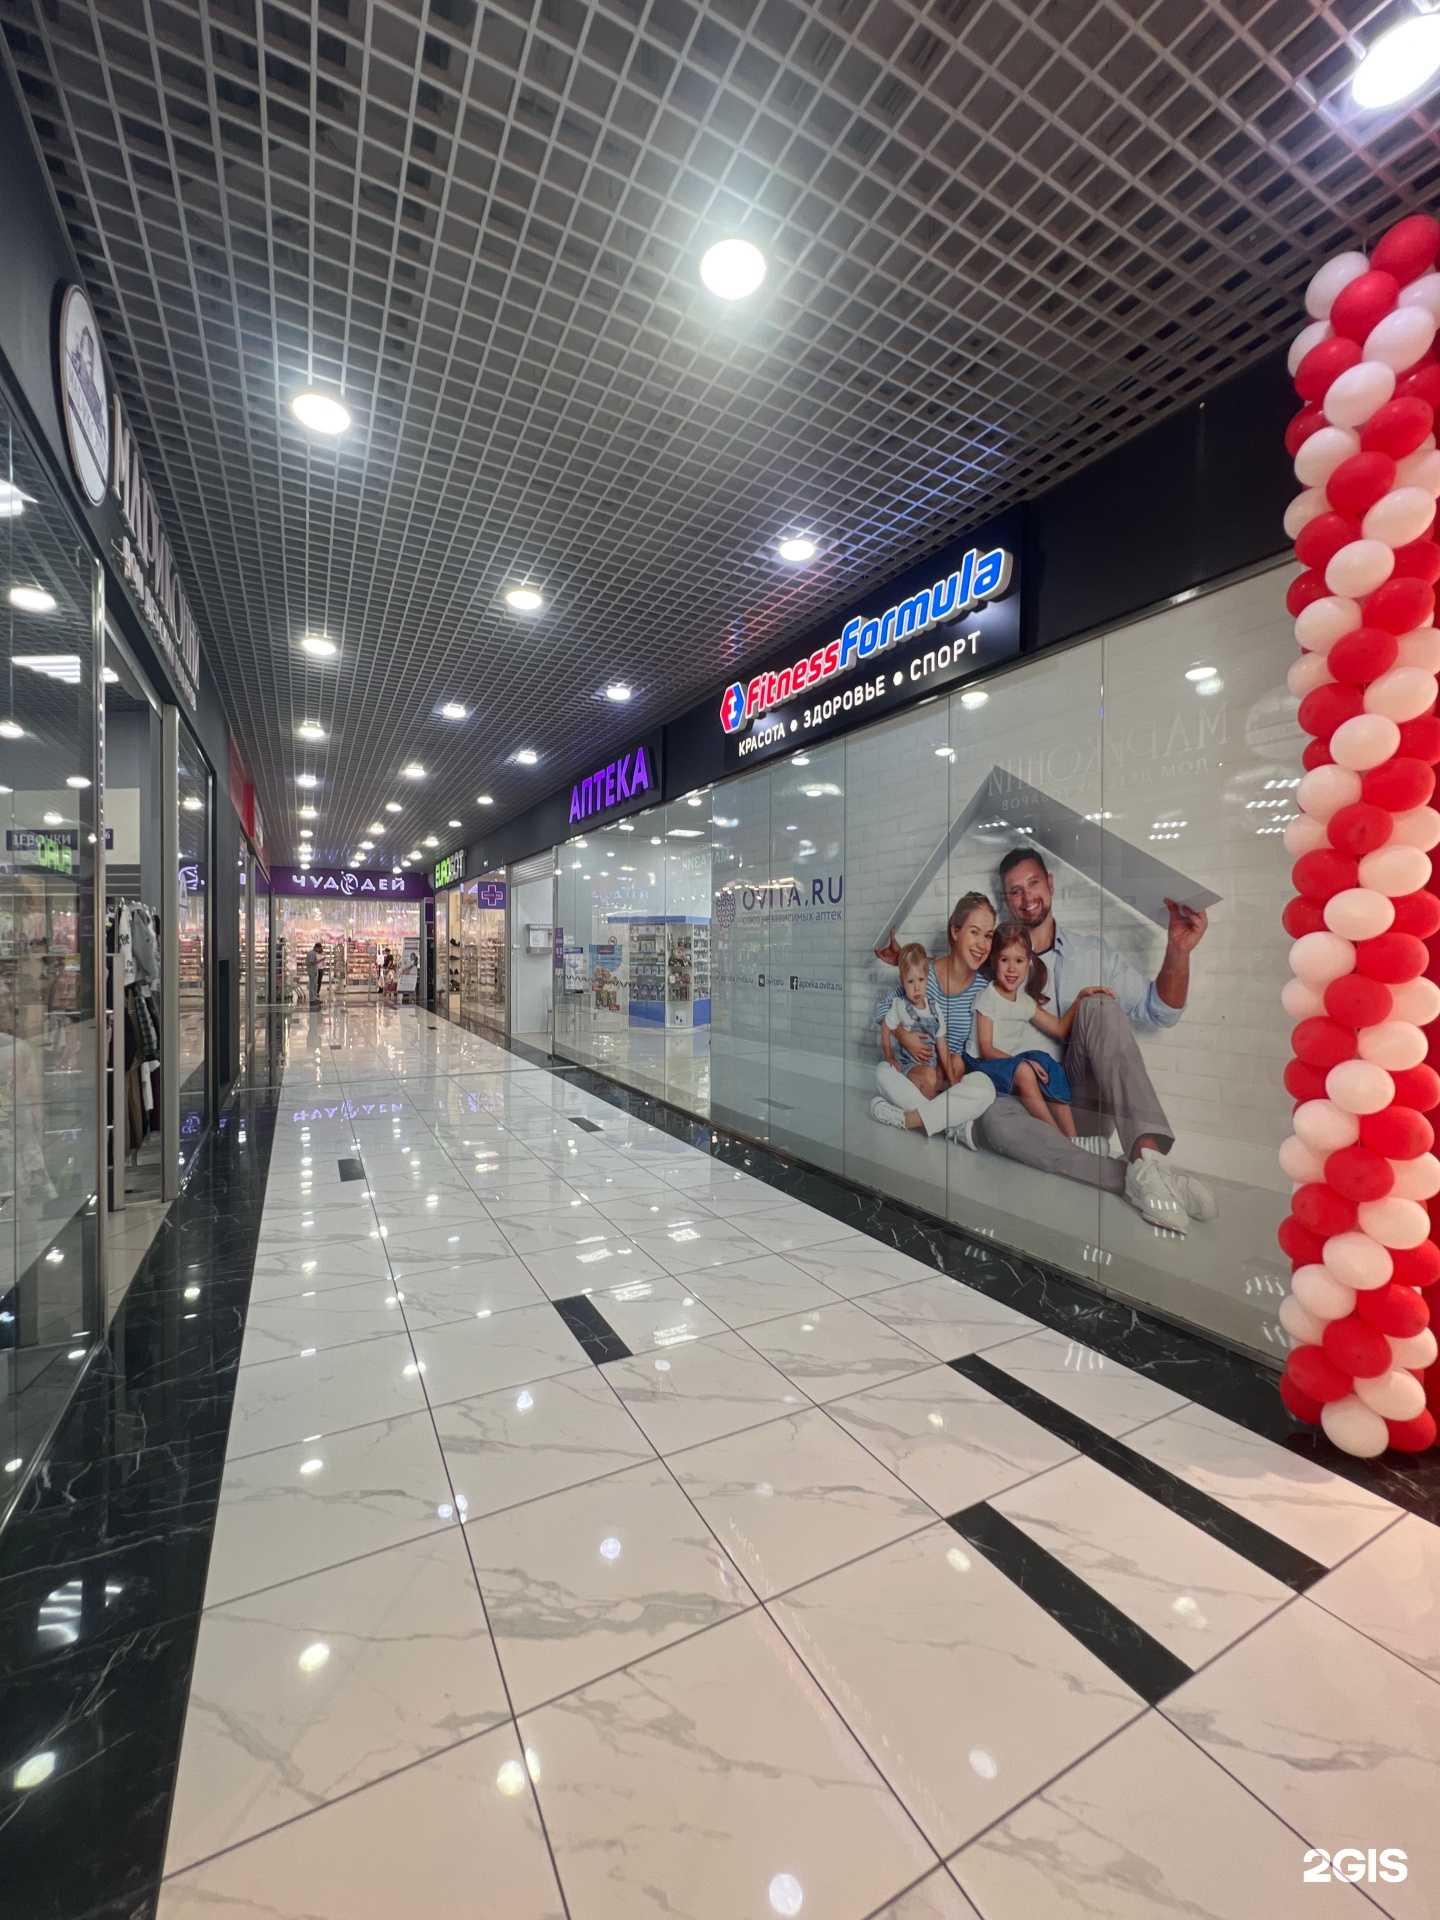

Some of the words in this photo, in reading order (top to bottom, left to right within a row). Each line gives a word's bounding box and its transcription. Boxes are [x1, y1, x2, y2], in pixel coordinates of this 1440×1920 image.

[738, 722, 786, 757] КРАСОТА
[803, 674, 886, 729] ЗДОРОВЬЕ
[910, 630, 982, 681] СПОРТ
[744, 547, 1008, 720] FitnessFormula
[568, 745, 649, 824] АПТЕКА
